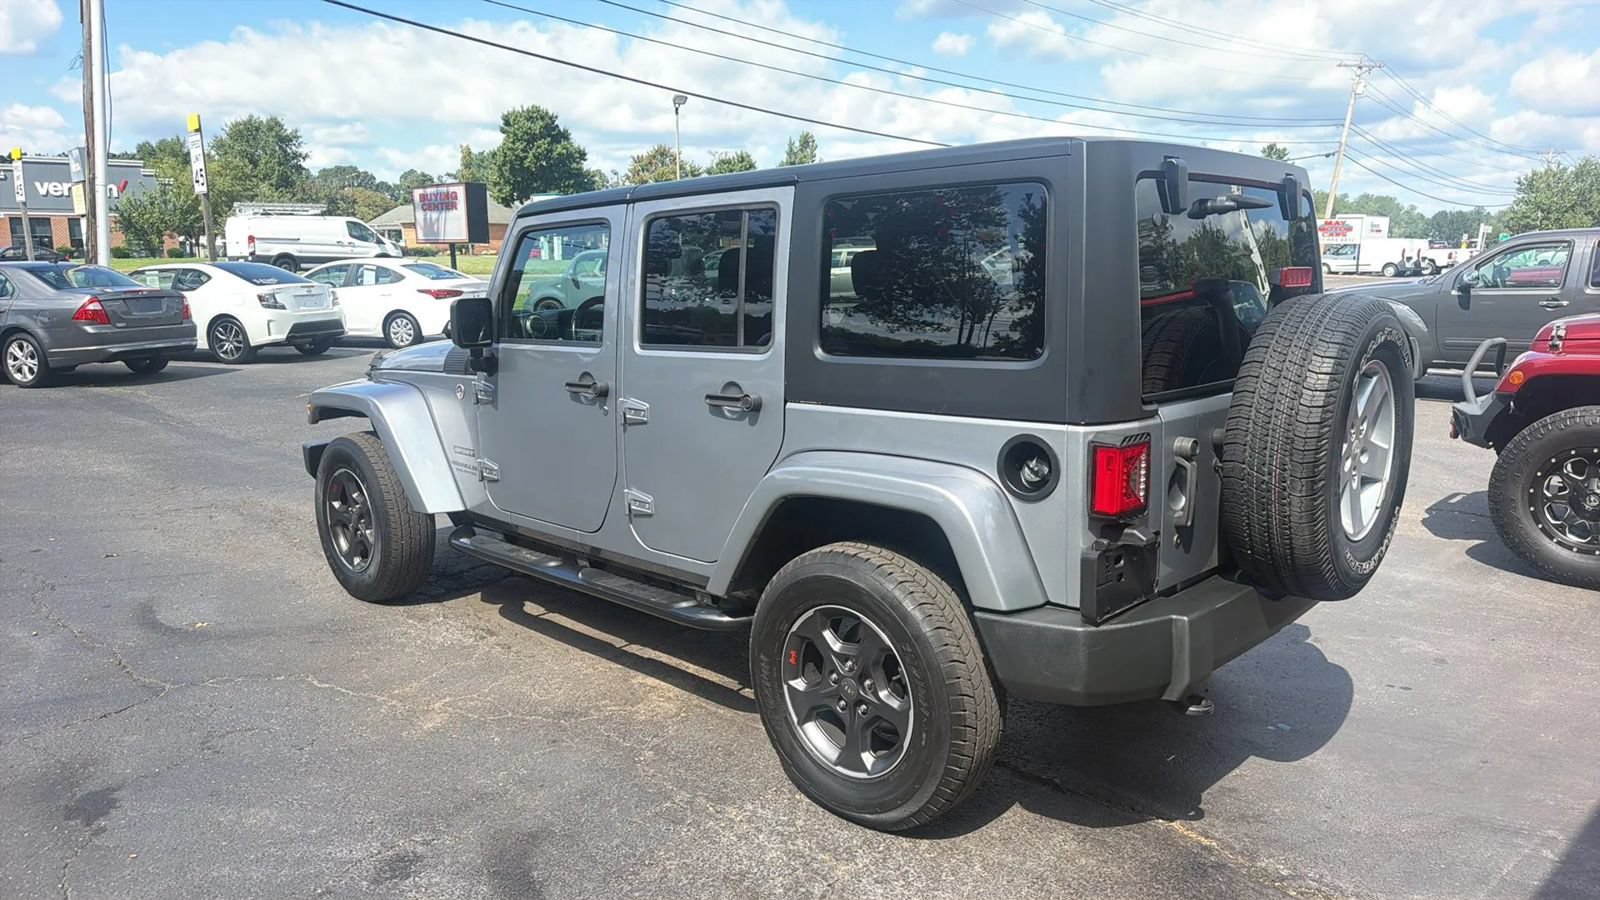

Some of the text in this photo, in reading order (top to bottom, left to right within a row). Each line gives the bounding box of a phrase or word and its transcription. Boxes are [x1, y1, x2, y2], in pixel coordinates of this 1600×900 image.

[34, 181, 119, 198] vern
[418, 191, 459, 203] BUYING
[421, 201, 458, 212] CENTER
